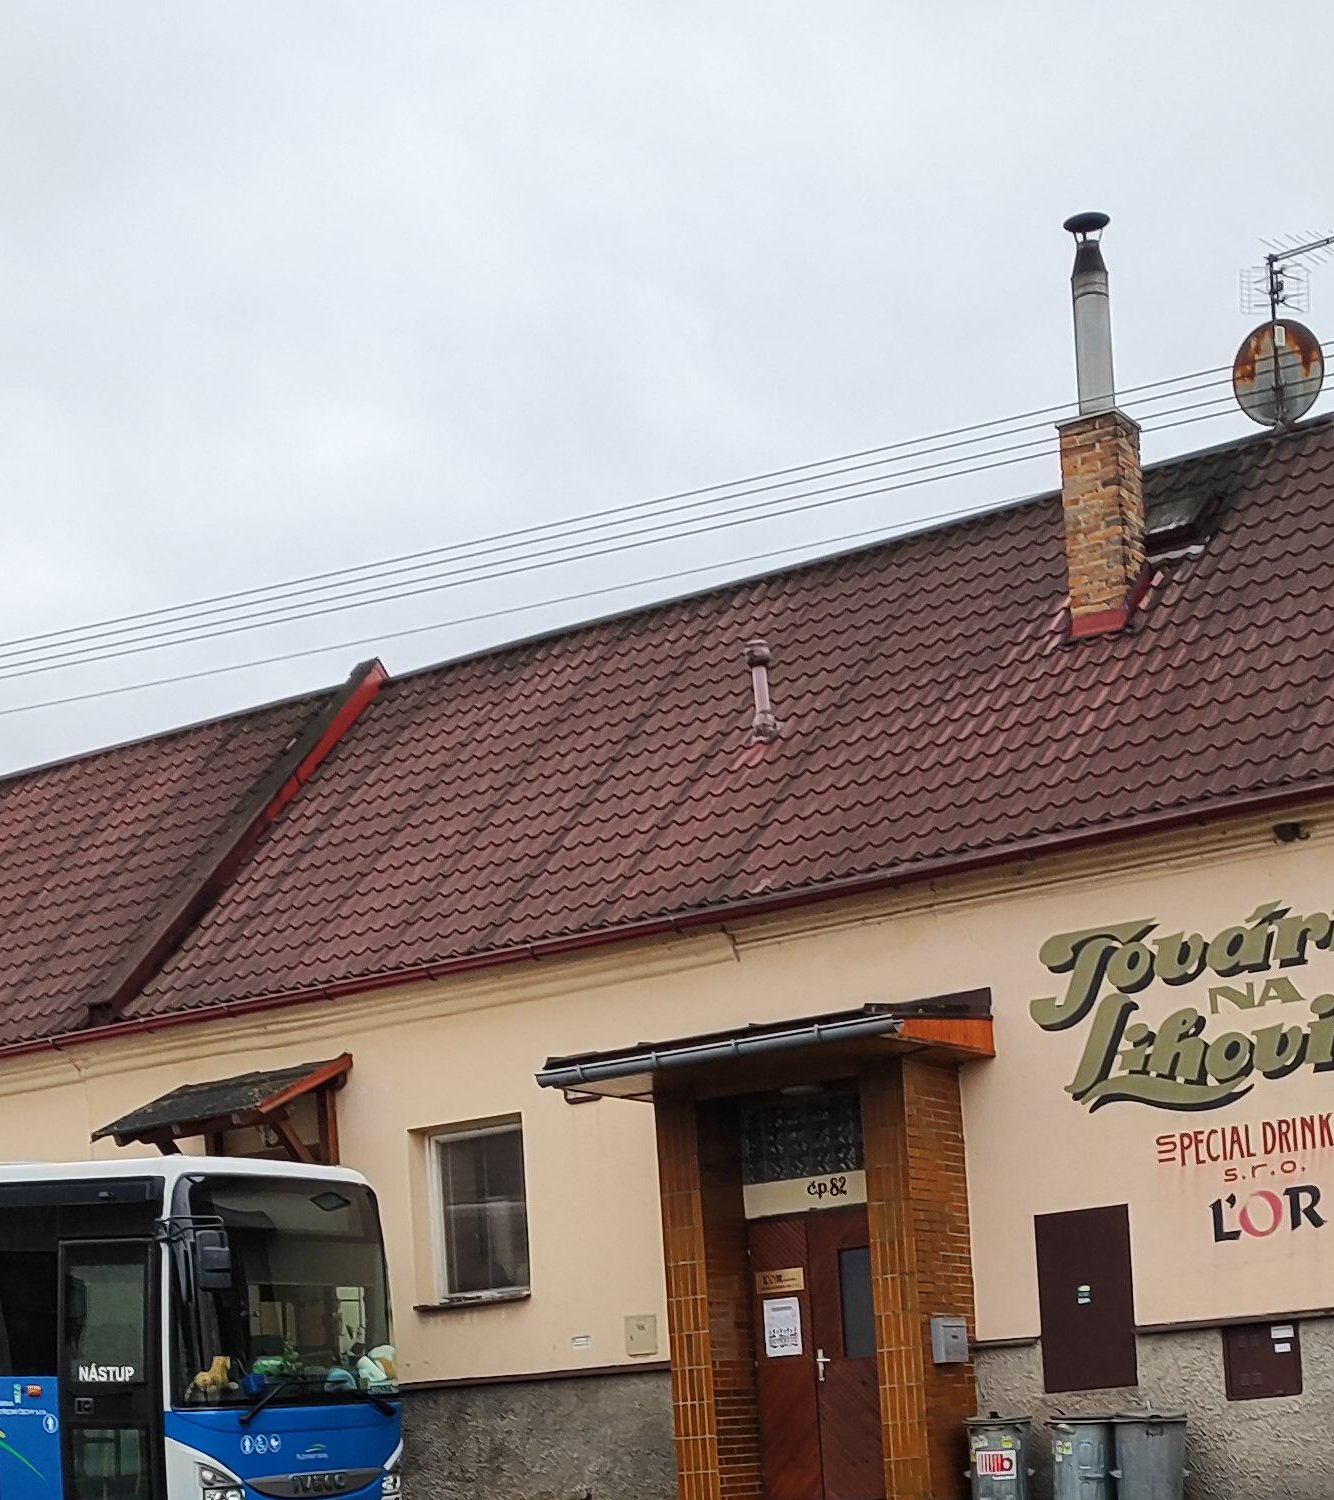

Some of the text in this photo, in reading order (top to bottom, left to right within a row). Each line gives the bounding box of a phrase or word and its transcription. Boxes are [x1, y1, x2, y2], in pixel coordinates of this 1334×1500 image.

[1208, 976, 1306, 1015] NA
[1155, 1124, 1257, 1167] SPECIAL
[1223, 1160, 1306, 1182] s.r.o.
[1208, 1185, 1328, 1243] L'OR
[78, 1362, 135, 1382] NÁSTUP
